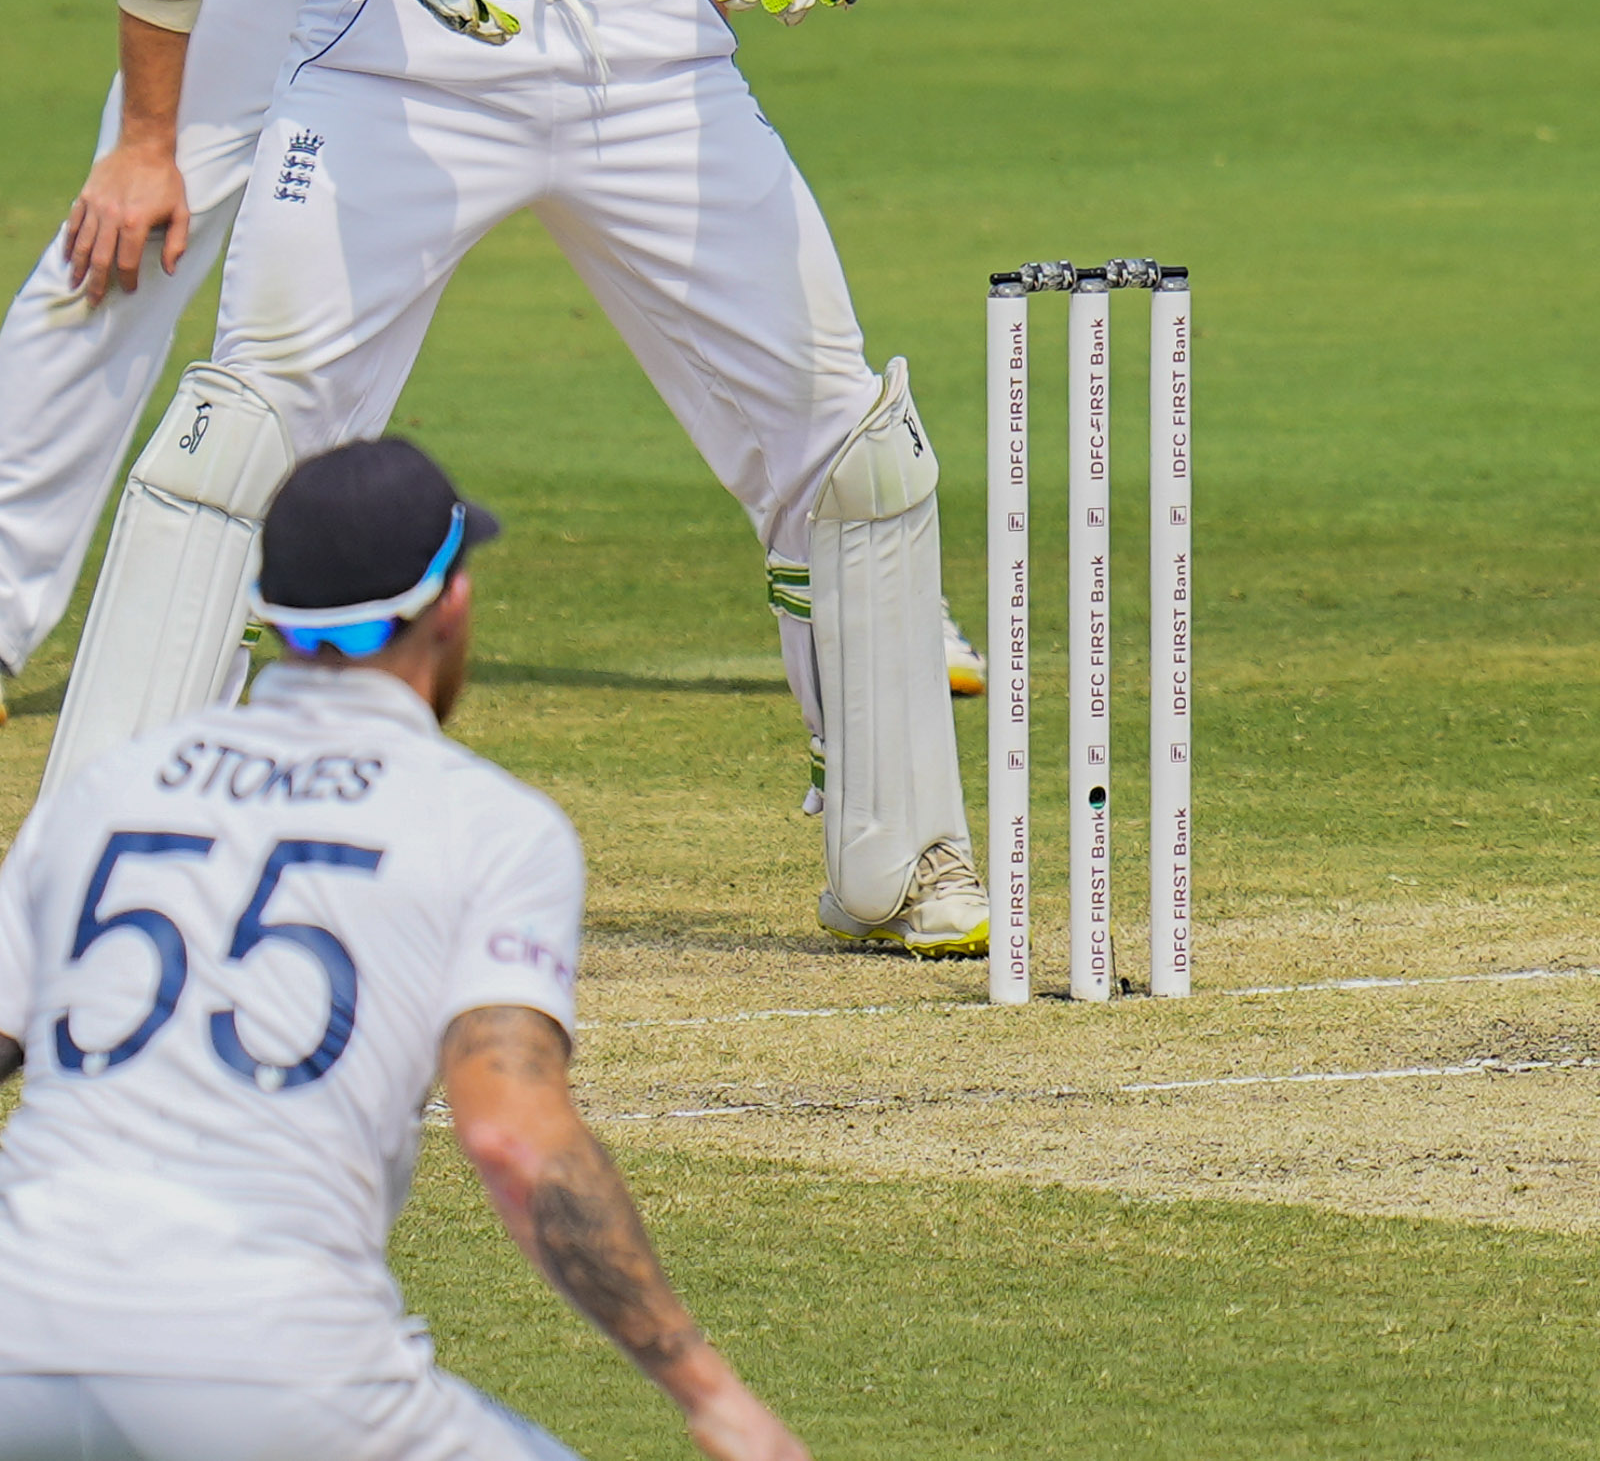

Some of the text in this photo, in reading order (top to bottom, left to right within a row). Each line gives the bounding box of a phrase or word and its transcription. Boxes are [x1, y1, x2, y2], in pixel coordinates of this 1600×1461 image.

[1010, 322, 1024, 485] IDFC FIRST Bank
[1090, 318, 1105, 480] IDFC FIRST Bank
[1173, 315, 1187, 479] IDFC FIRST Bank
[1010, 560, 1024, 723] IDFC FIRST Bank
[1090, 555, 1105, 718] IDFC FIRST Bank
[1173, 553, 1187, 716] IDFC FIRST Bank
[158, 740, 383, 801] STOKES
[54, 830, 384, 1092] 55
[487, 923, 570, 987] cin
[1010, 815, 1024, 980] IDFC FIRST Bank
[1090, 811, 1105, 975] IDFC FIRST Bank
[1173, 808, 1187, 973] IDFC FIRST Bank
